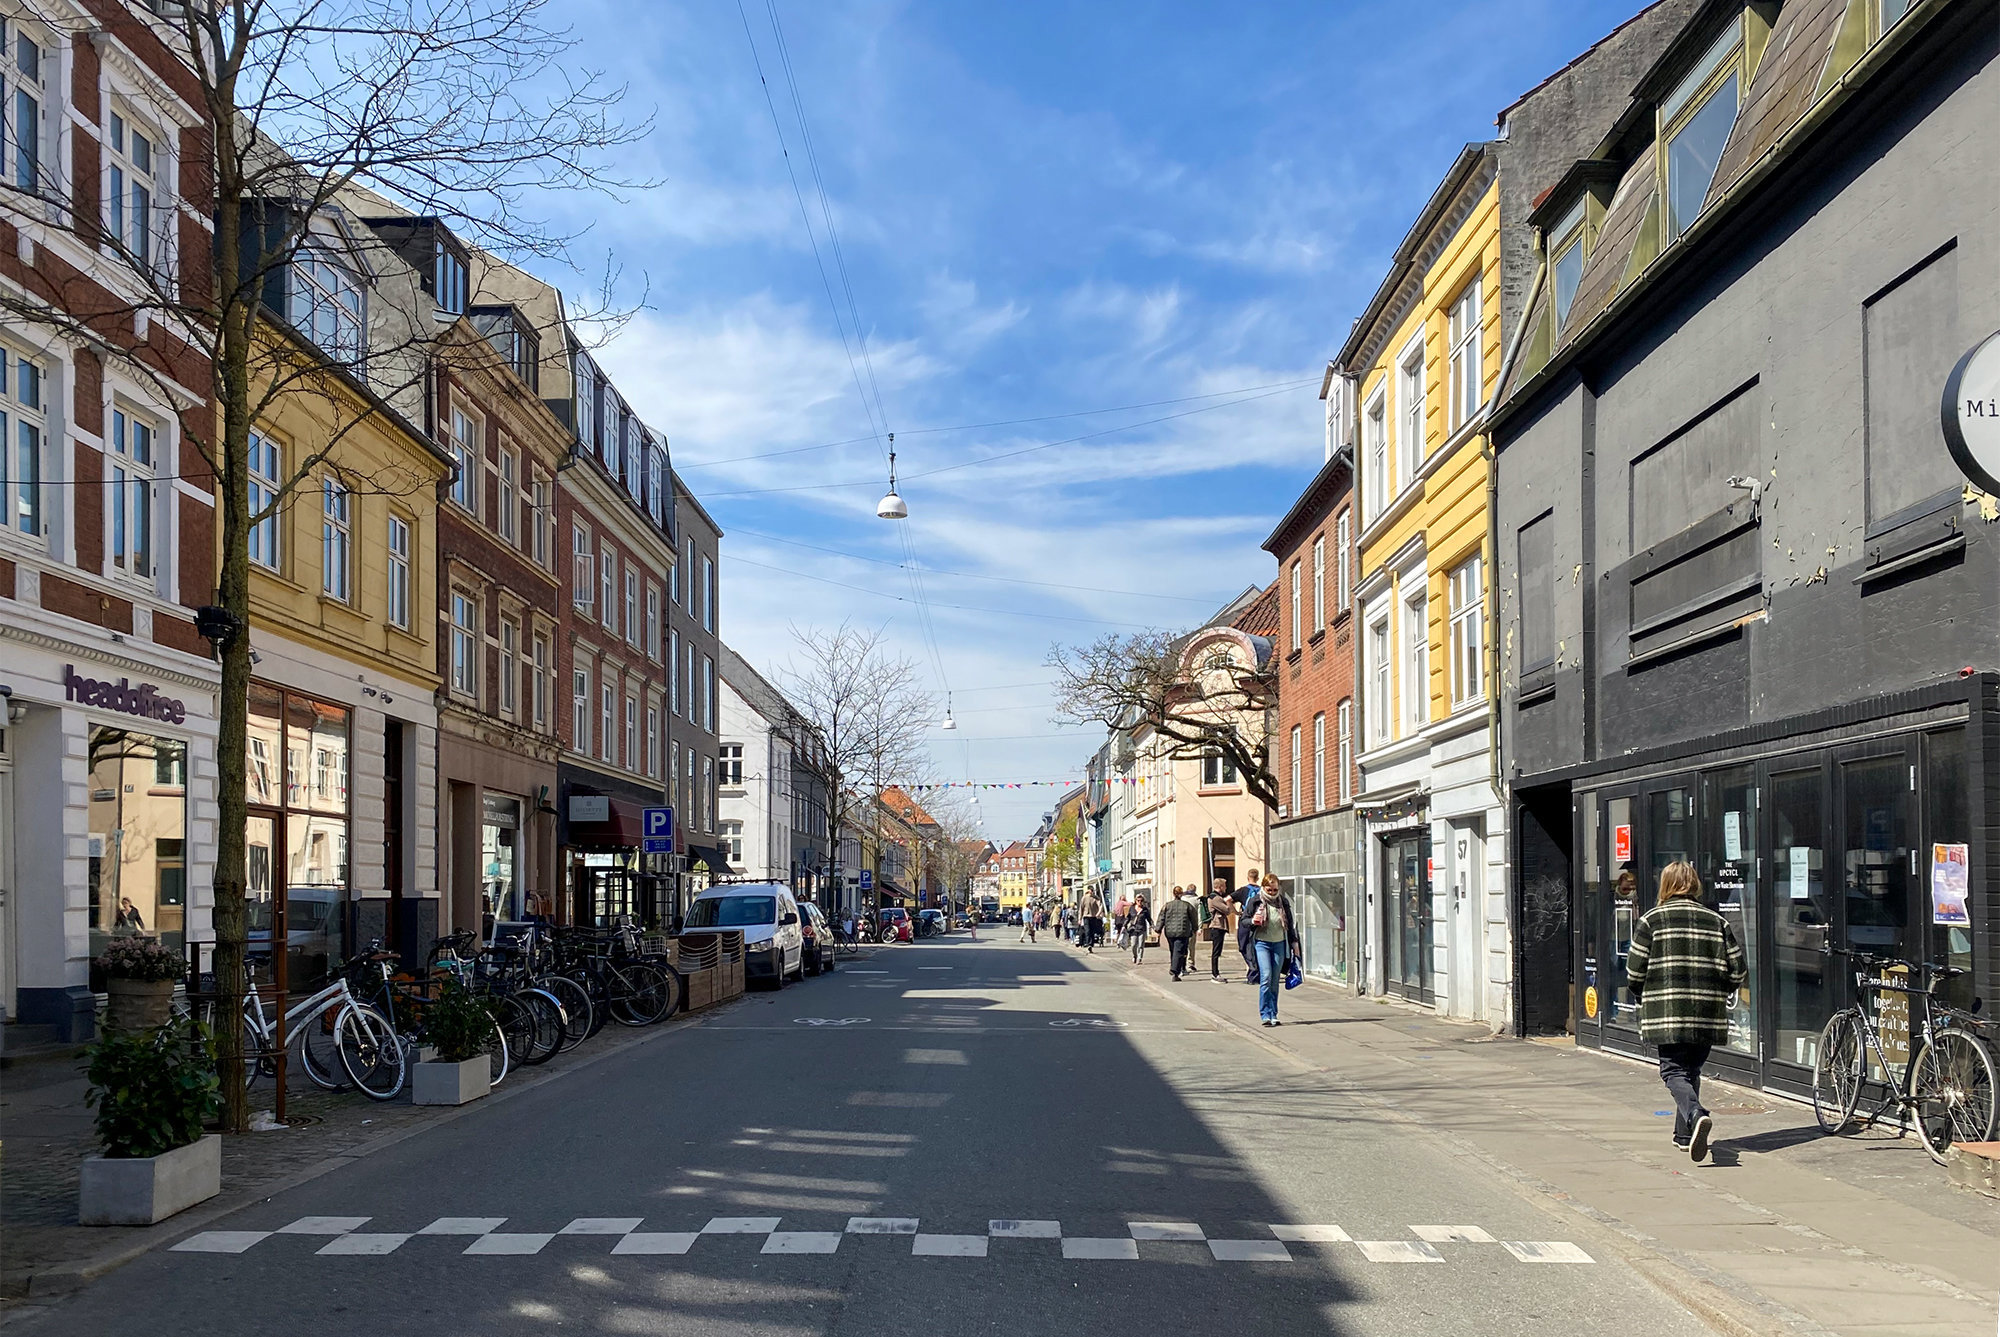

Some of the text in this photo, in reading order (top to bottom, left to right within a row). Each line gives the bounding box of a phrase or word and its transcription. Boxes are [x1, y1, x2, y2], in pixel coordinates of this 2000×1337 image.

[1967, 399, 2000, 417] Mi
[65, 663, 186, 725] headoffice
[650, 812, 667, 834] P
[863, 872, 870, 880] P
